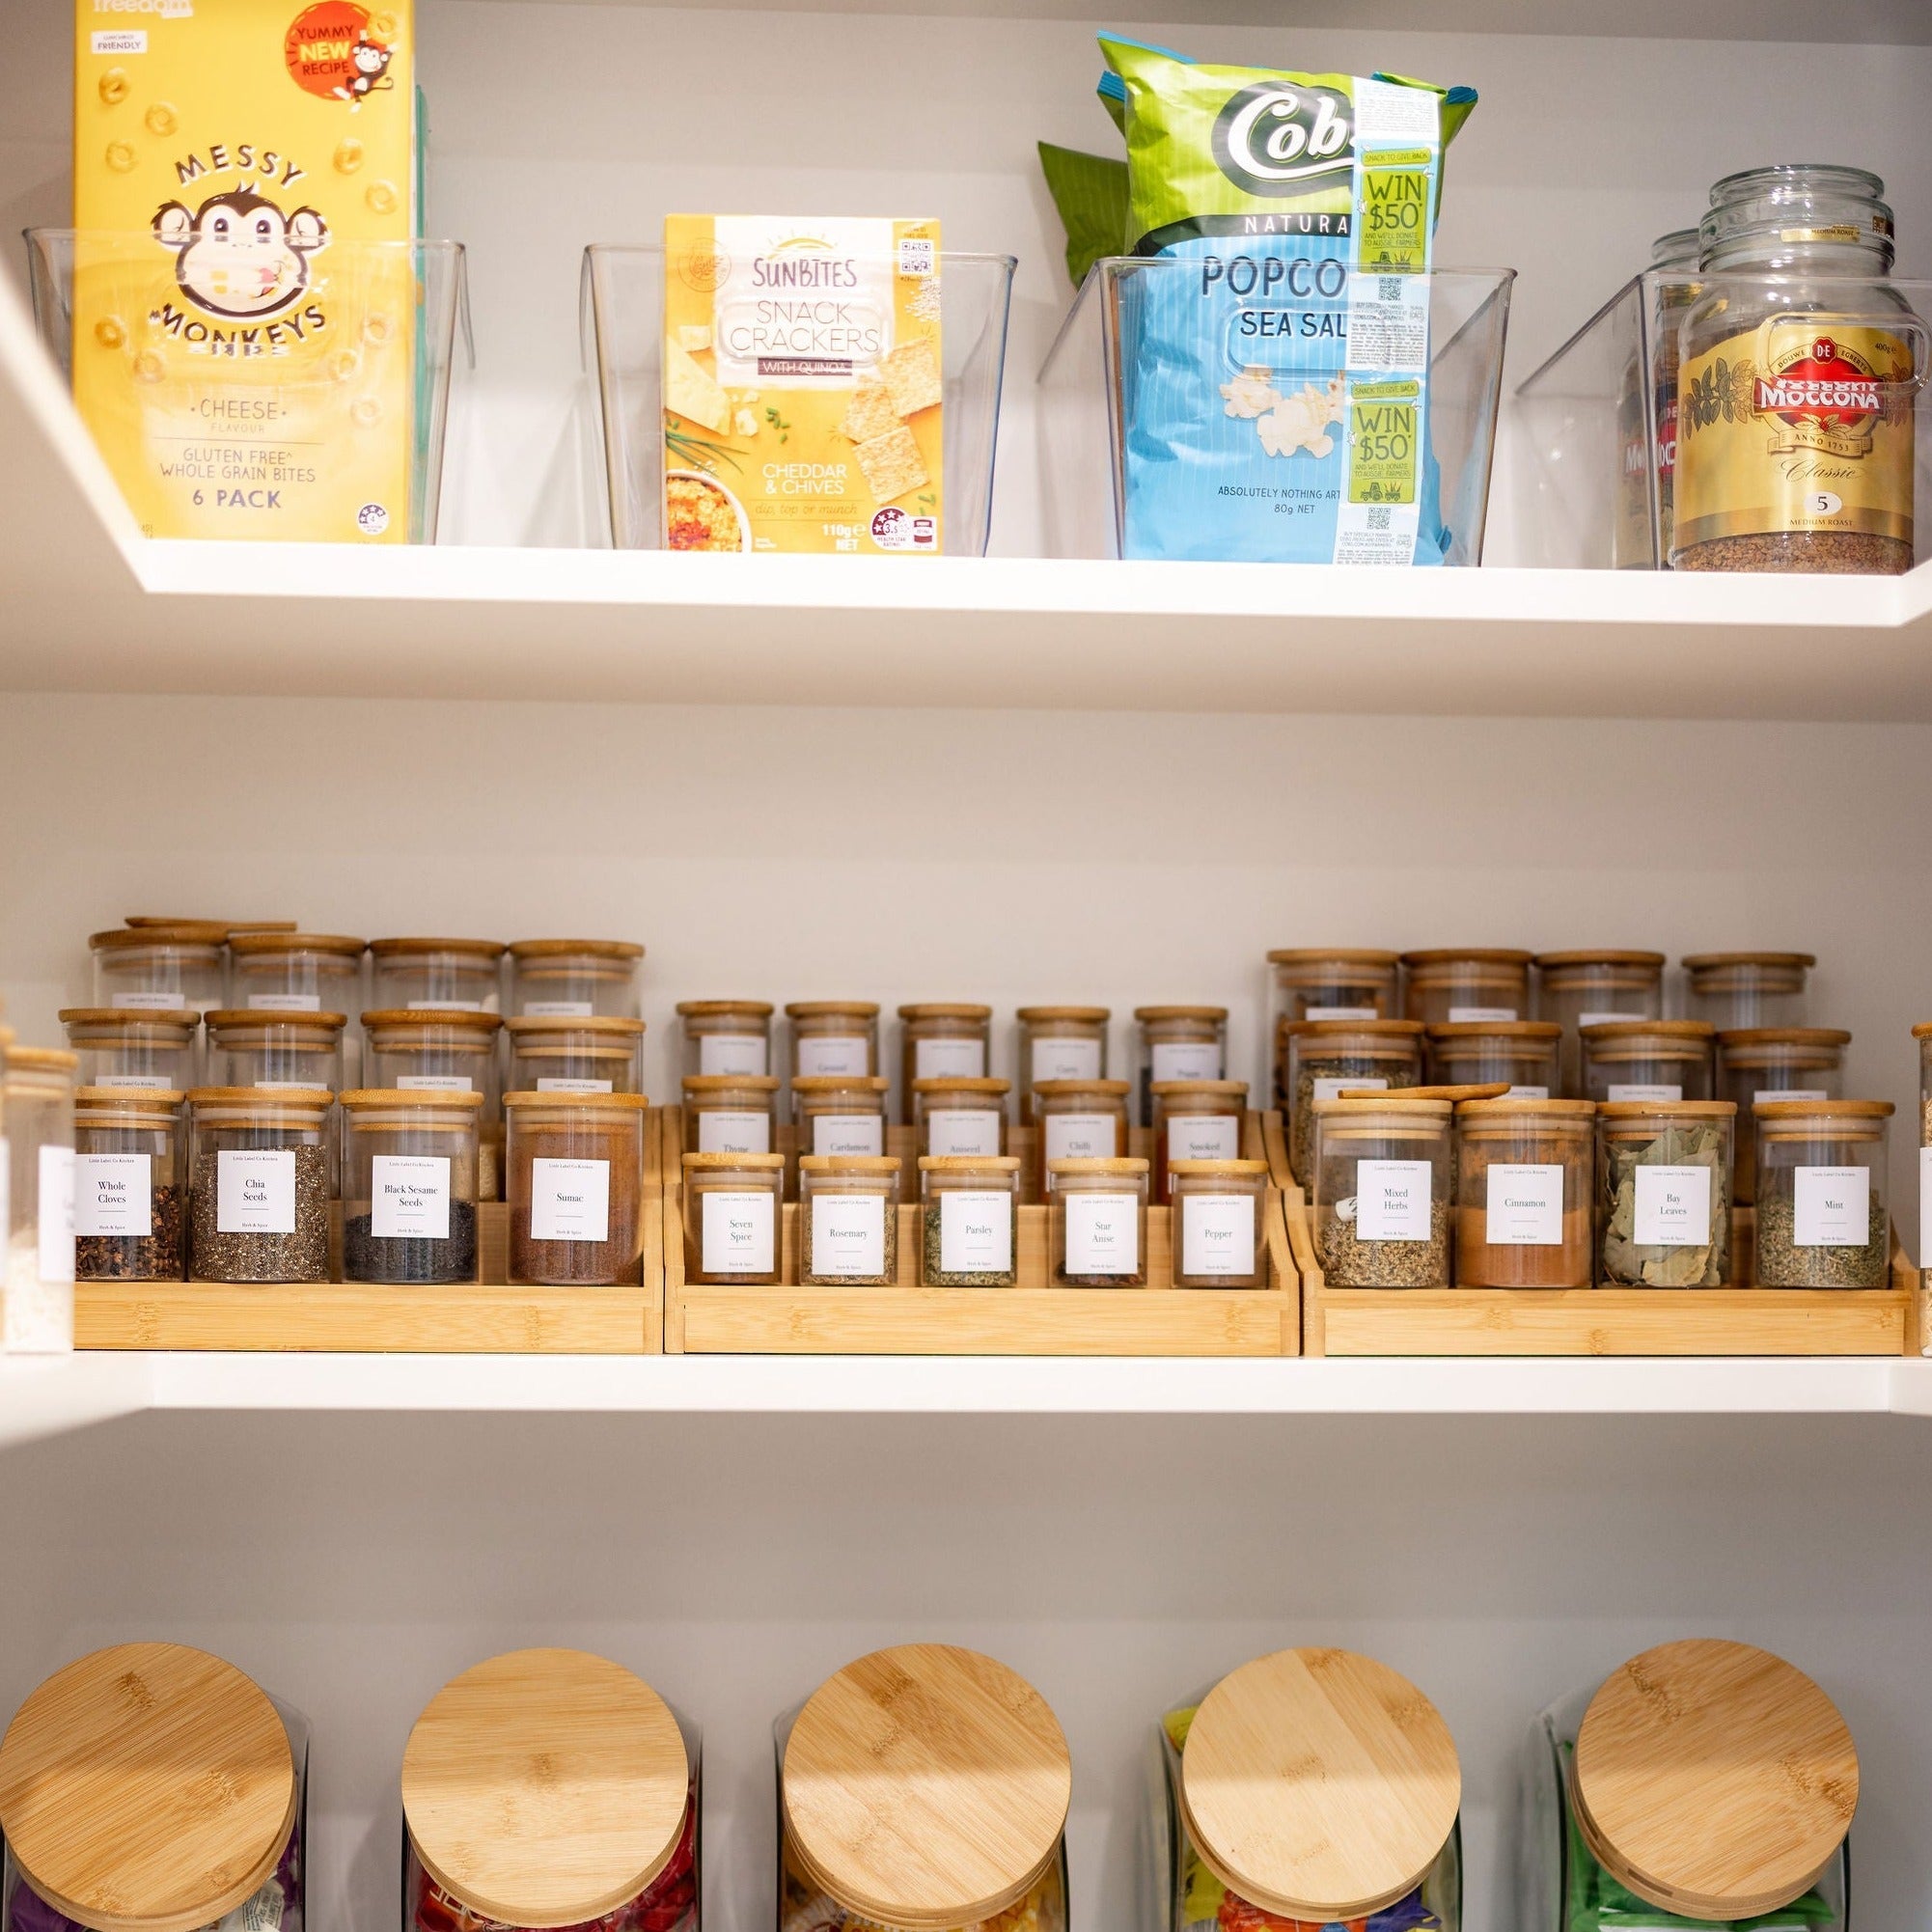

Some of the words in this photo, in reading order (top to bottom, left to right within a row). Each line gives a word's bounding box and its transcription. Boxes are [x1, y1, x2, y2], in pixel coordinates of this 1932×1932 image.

[296, 24, 354, 40] YUMMY
[97, 41, 142, 50] FRIENDLY
[299, 41, 351, 62] NEW
[302, 61, 350, 76] RECIPE
[1228, 91, 1354, 179] Cob
[174, 144, 307, 188] MESSY
[1367, 174, 1421, 201] WIN
[1245, 214, 1348, 234] NATURA
[752, 258, 858, 288] SUNBITES
[1201, 255, 1348, 299] POPCO
[756, 300, 852, 324] SNACK
[160, 301, 327, 345] MONKEYS
[1240, 311, 1292, 337] SEA
[1300, 312, 1347, 338] SAL
[730, 327, 880, 353] CRACKERS
[762, 361, 796, 373] WITH
[1778, 349, 1806, 369] DOUWE
[1841, 350, 1868, 373] EGBERTS
[1760, 380, 1881, 409] MOCCONA
[200, 399, 278, 420] CHEESE
[1357, 406, 1410, 433] WIN
[210, 423, 265, 433] FLAVOUR
[1795, 433, 1824, 446] ANNO
[1827, 440, 1850, 452] 1753
[183, 448, 242, 462] GLUTEN
[160, 463, 216, 479] WHOLE
[222, 465, 266, 480] GRAIN
[273, 468, 317, 483] BITES
[761, 463, 848, 479] CHEDDAR
[1780, 457, 1863, 482] Classic
[765, 480, 778, 495] &
[782, 480, 844, 496] CHIVES
[1218, 485, 1278, 499] ABSOLUTELY
[1281, 488, 1322, 499] NOTHING
[1325, 489, 1340, 500] ART
[193, 489, 204, 506] 6
[216, 489, 281, 509] PACK
[1816, 496, 1828, 511] 5
[780, 503, 798, 516] top
[803, 505, 814, 513] or
[818, 502, 858, 514] munch
[1274, 504, 1293, 515] 80g
[1297, 505, 1315, 514] NET
[1789, 518, 1827, 527] MEDIUM
[1828, 518, 1854, 527] ROAST
[836, 538, 858, 551] NET
[97, 1180, 126, 1190] Whole
[245, 1178, 265, 1189] Chia
[384, 1184, 406, 1194] Black
[407, 1185, 438, 1195] Sesame
[97, 1194, 126, 1203] Cloves
[243, 1191, 267, 1201] Seeds
[556, 1193, 584, 1202] Sumac
[1384, 1188, 1408, 1198] Mixed
[1667, 1194, 1681, 1204] Bay
[399, 1197, 423, 1207] Seeds
[1384, 1201, 1408, 1210] Herbs
[1504, 1198, 1546, 1208] Cinnamon
[1825, 1201, 1843, 1209] Mint
[1660, 1206, 1687, 1216] Leaves
[729, 1219, 753, 1228] Seven
[965, 1225, 993, 1236] Parsley
[1094, 1221, 1112, 1230] Star
[730, 1231, 753, 1243] Spice
[829, 1228, 868, 1240] Rosemary
[1091, 1233, 1115, 1243] Anise
[1204, 1228, 1233, 1240] Pepper
